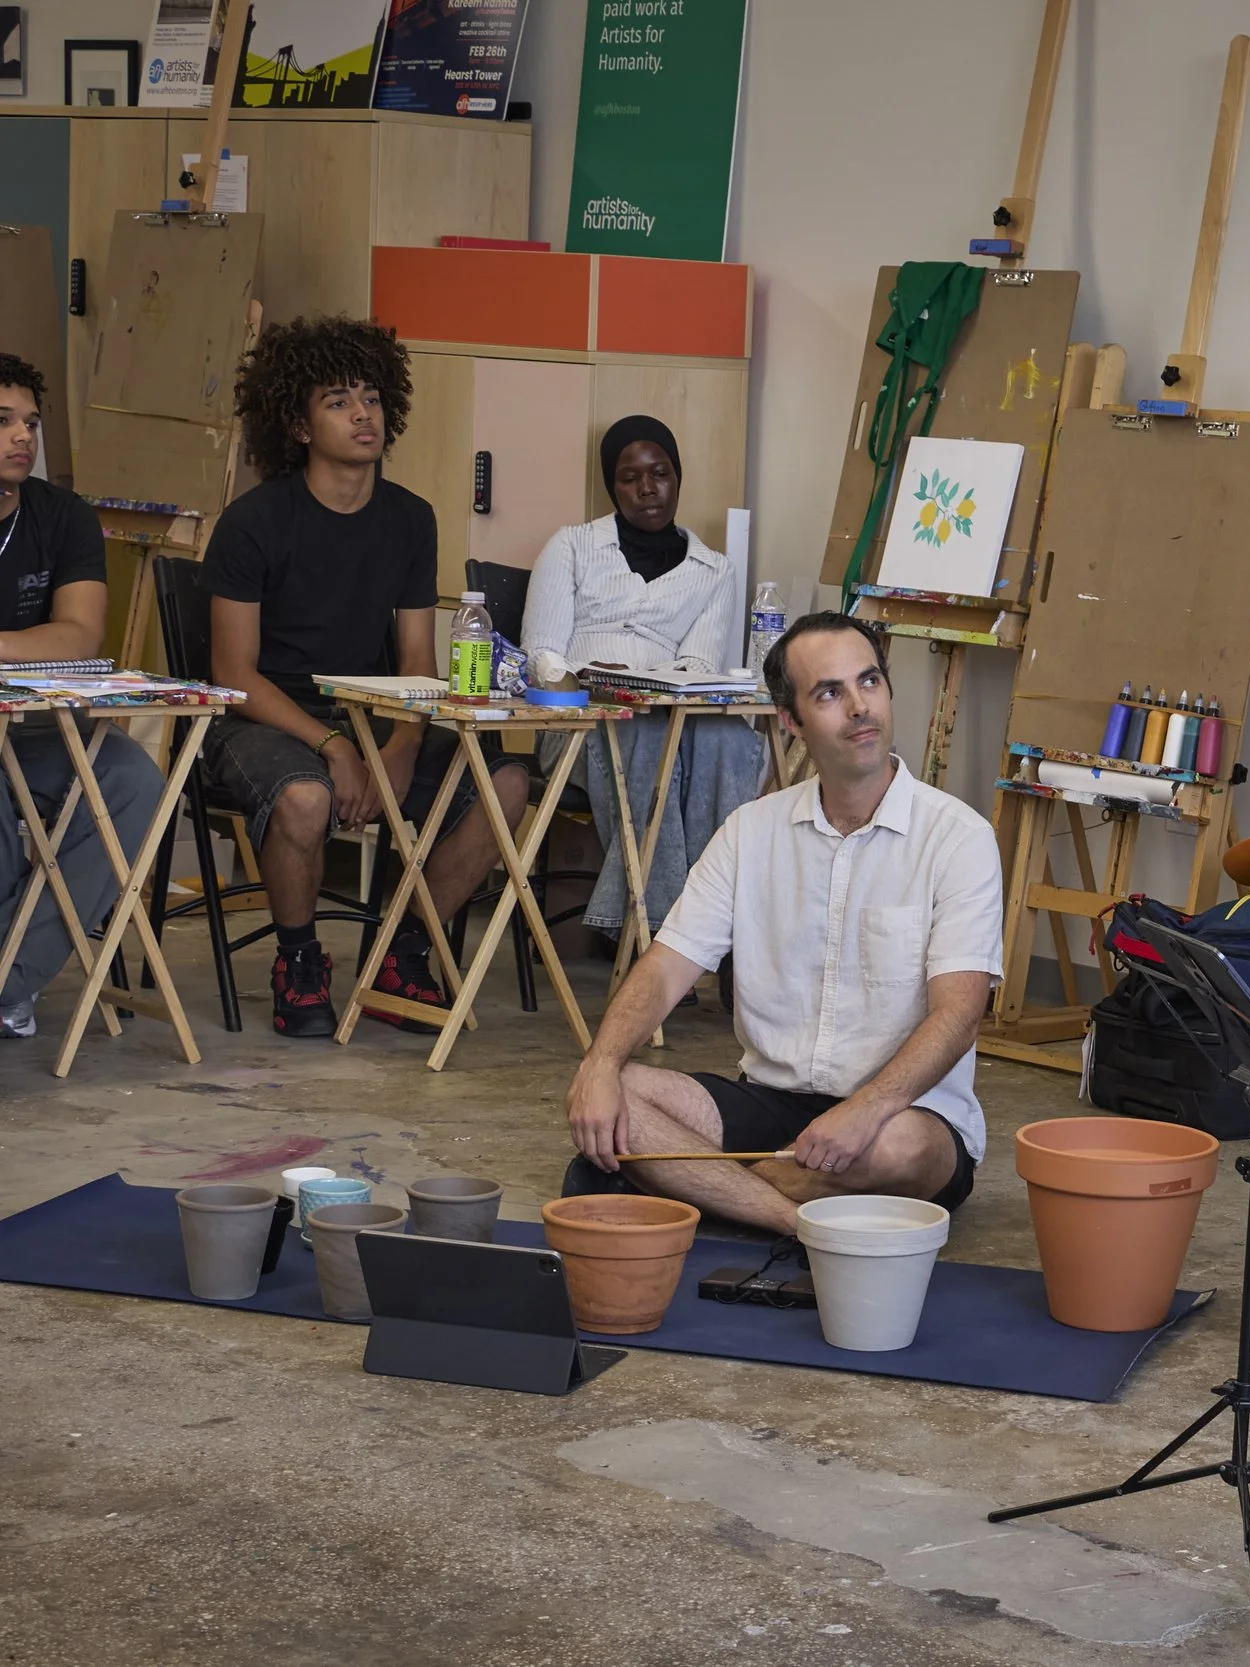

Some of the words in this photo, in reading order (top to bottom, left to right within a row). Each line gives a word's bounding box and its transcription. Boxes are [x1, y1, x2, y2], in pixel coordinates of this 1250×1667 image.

[602, 0, 631, 21] paid
[635, 0, 667, 16] work
[670, 0, 684, 15] at
[600, 25, 642, 43] Artists
[645, 25, 665, 43] for
[469, 46, 485, 56] FEB
[485, 45, 507, 57] 26th
[167, 59, 192, 71] artists
[598, 51, 663, 74] Humanity.
[163, 71, 200, 84] humanity
[444, 69, 474, 80] Hearst
[475, 69, 502, 81] Tower
[587, 196, 628, 214] artists
[628, 204, 639, 214] for
[583, 209, 656, 237] humanity
